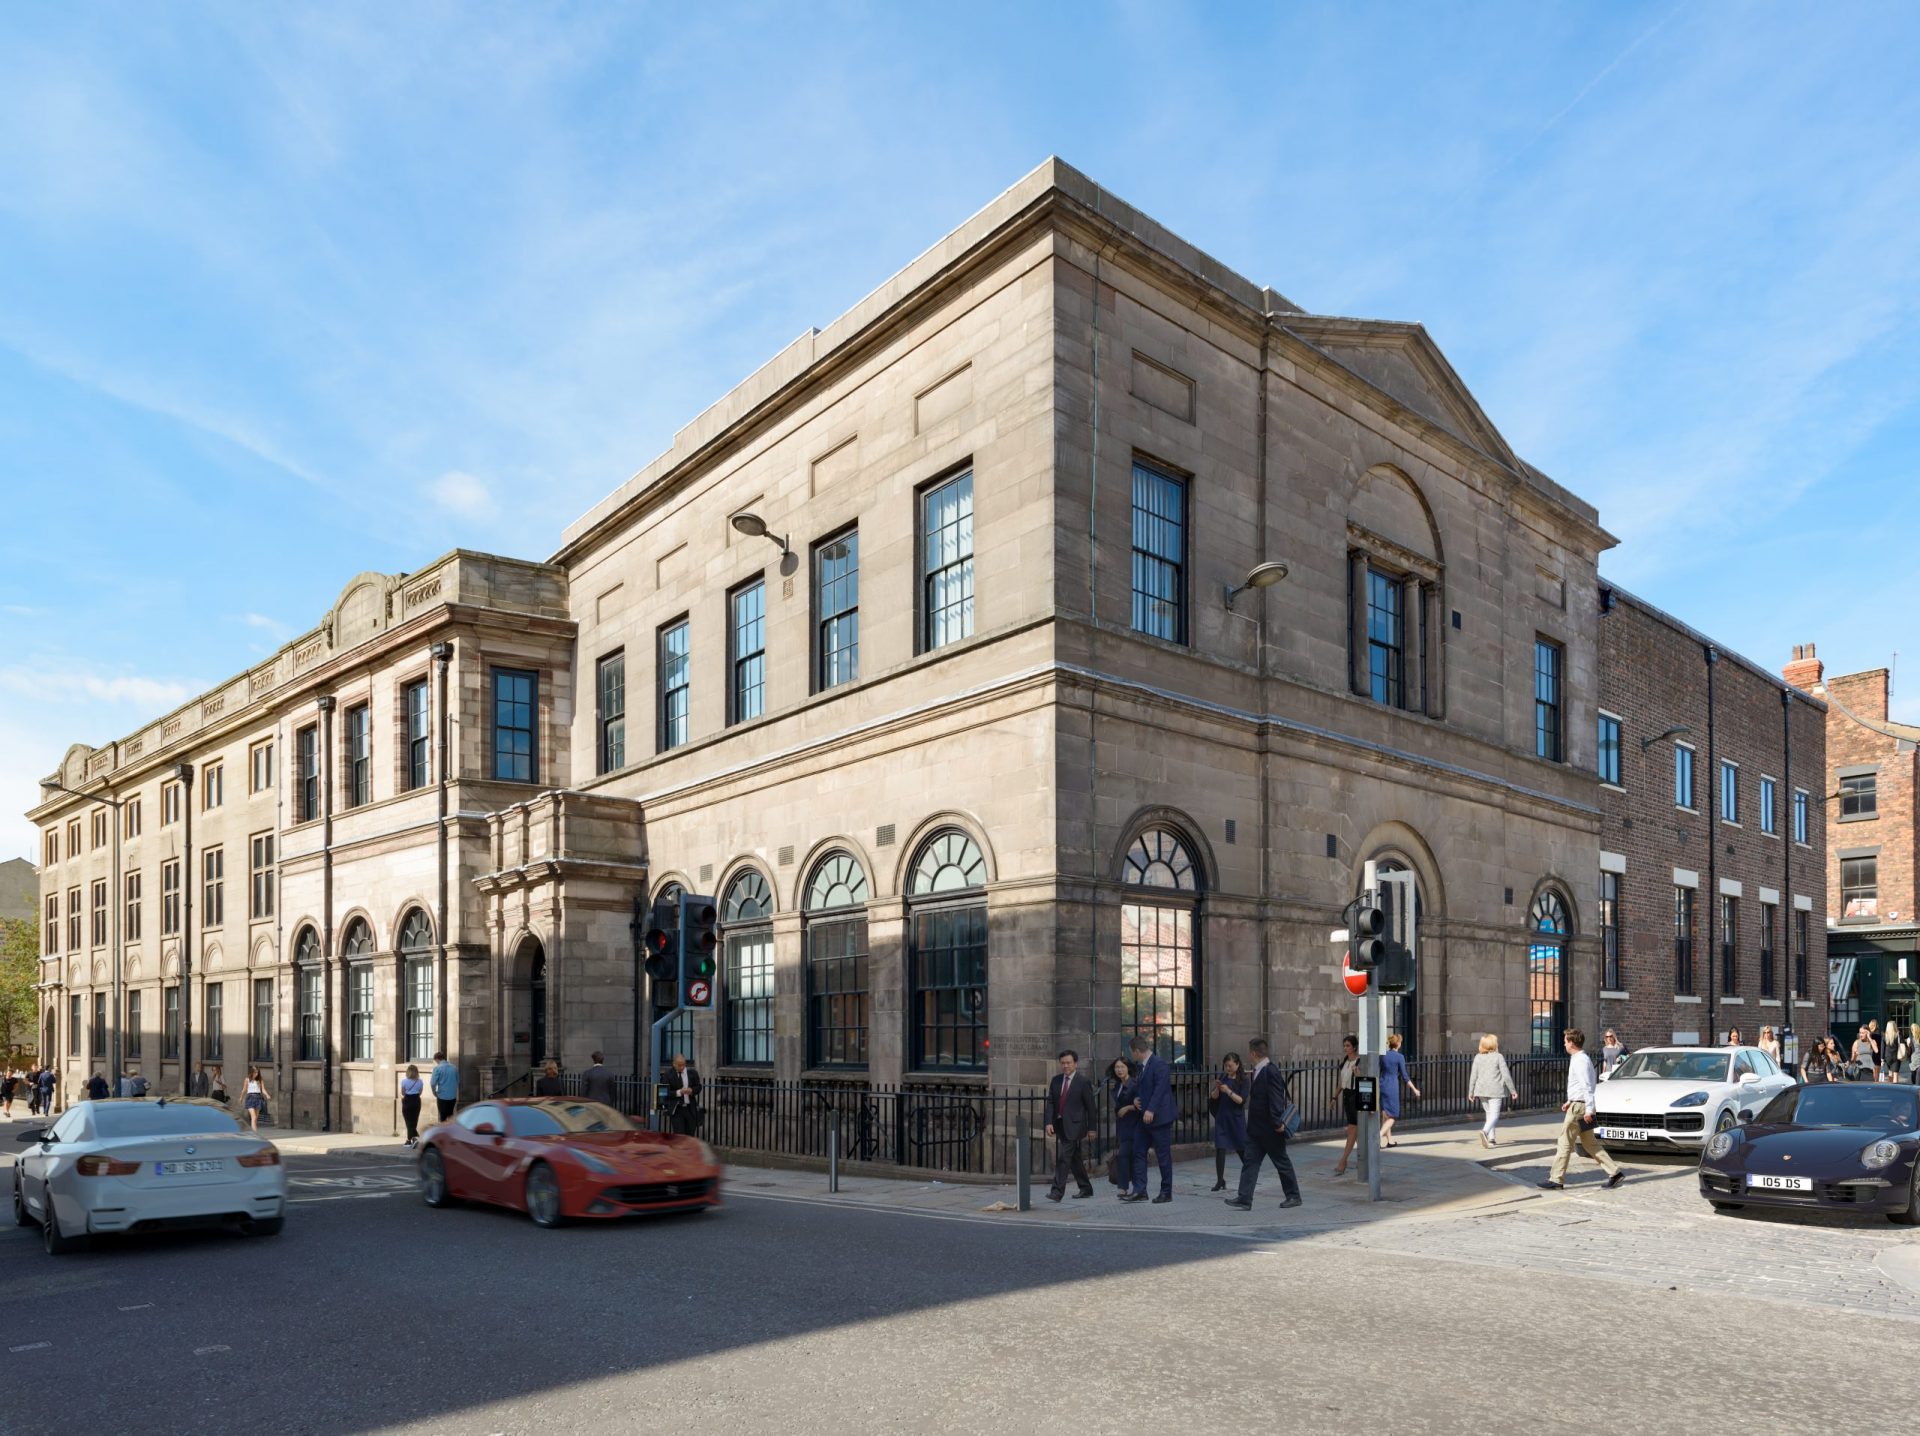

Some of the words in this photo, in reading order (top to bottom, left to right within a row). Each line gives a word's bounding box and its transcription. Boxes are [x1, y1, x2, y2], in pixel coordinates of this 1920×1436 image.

[1606, 1130, 1625, 1139] ED19
[1628, 1131, 1645, 1140] MAE
[1762, 1177, 1781, 1188] 105
[1785, 1178, 1801, 1189] DS
